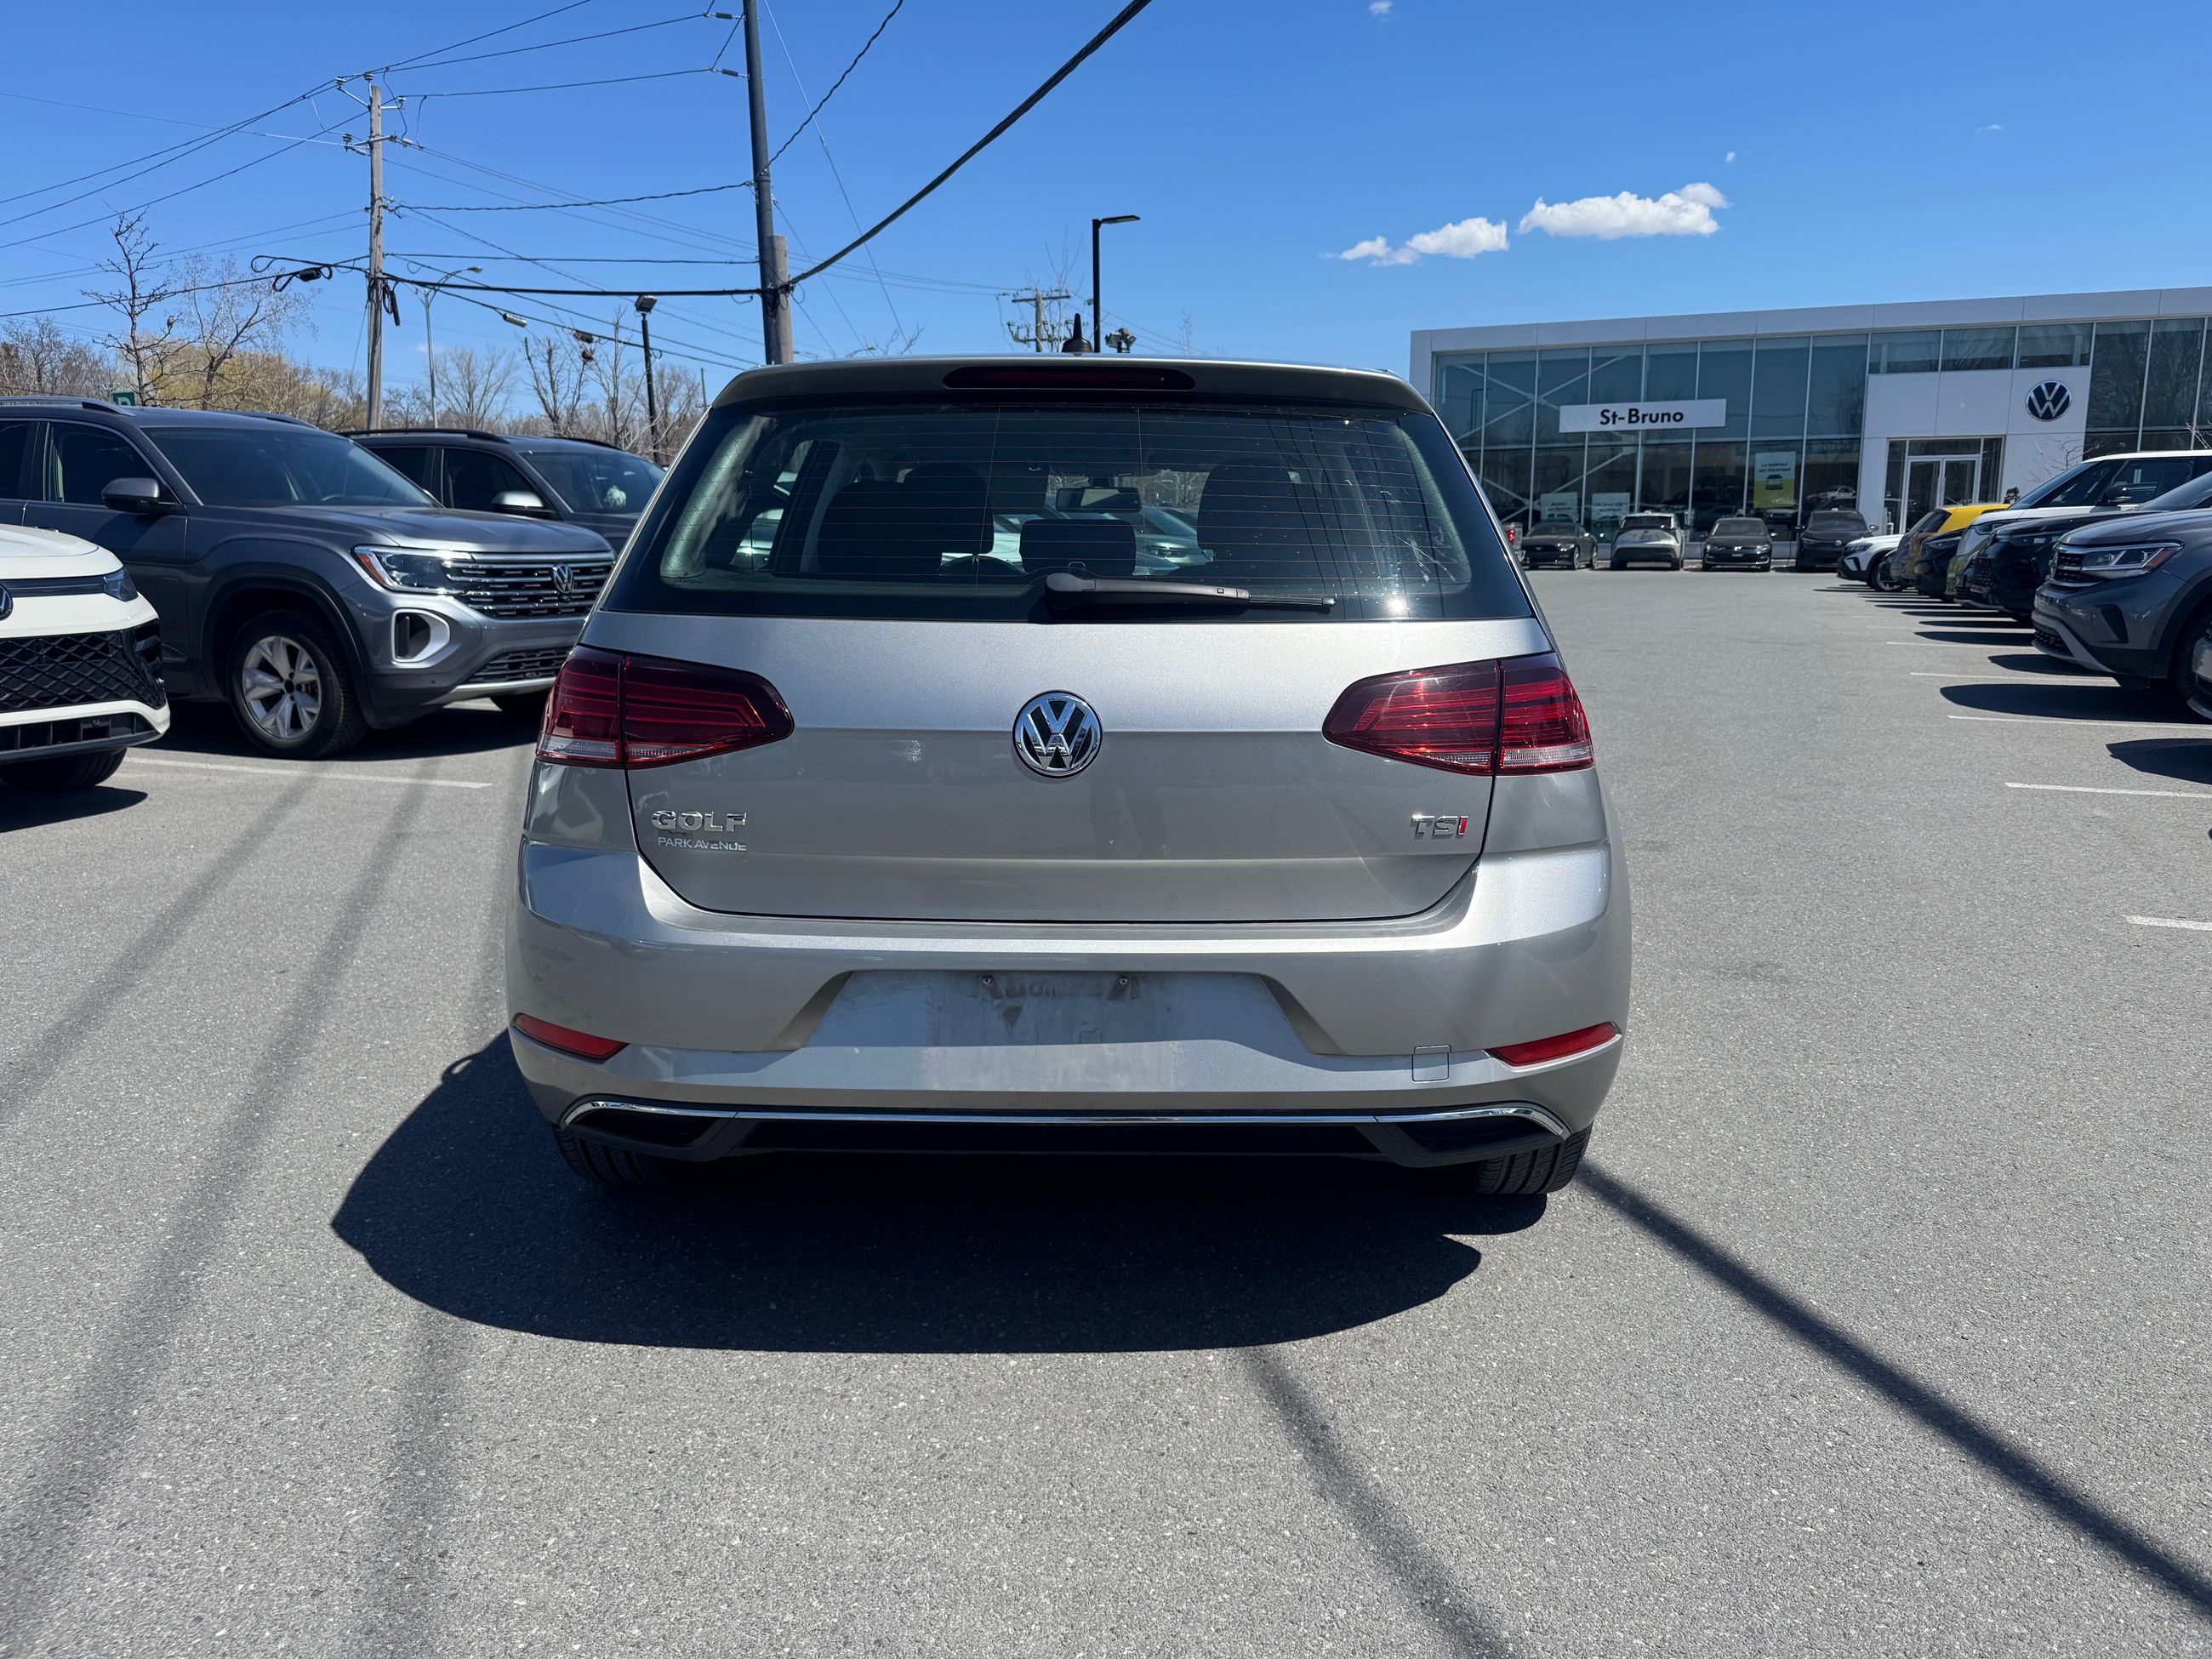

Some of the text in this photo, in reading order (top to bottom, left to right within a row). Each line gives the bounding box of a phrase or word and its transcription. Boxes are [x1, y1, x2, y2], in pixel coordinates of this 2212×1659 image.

[1599, 408, 1684, 425] St-Bruno
[652, 810, 747, 832] GOLF
[1411, 815, 1468, 837] TSI
